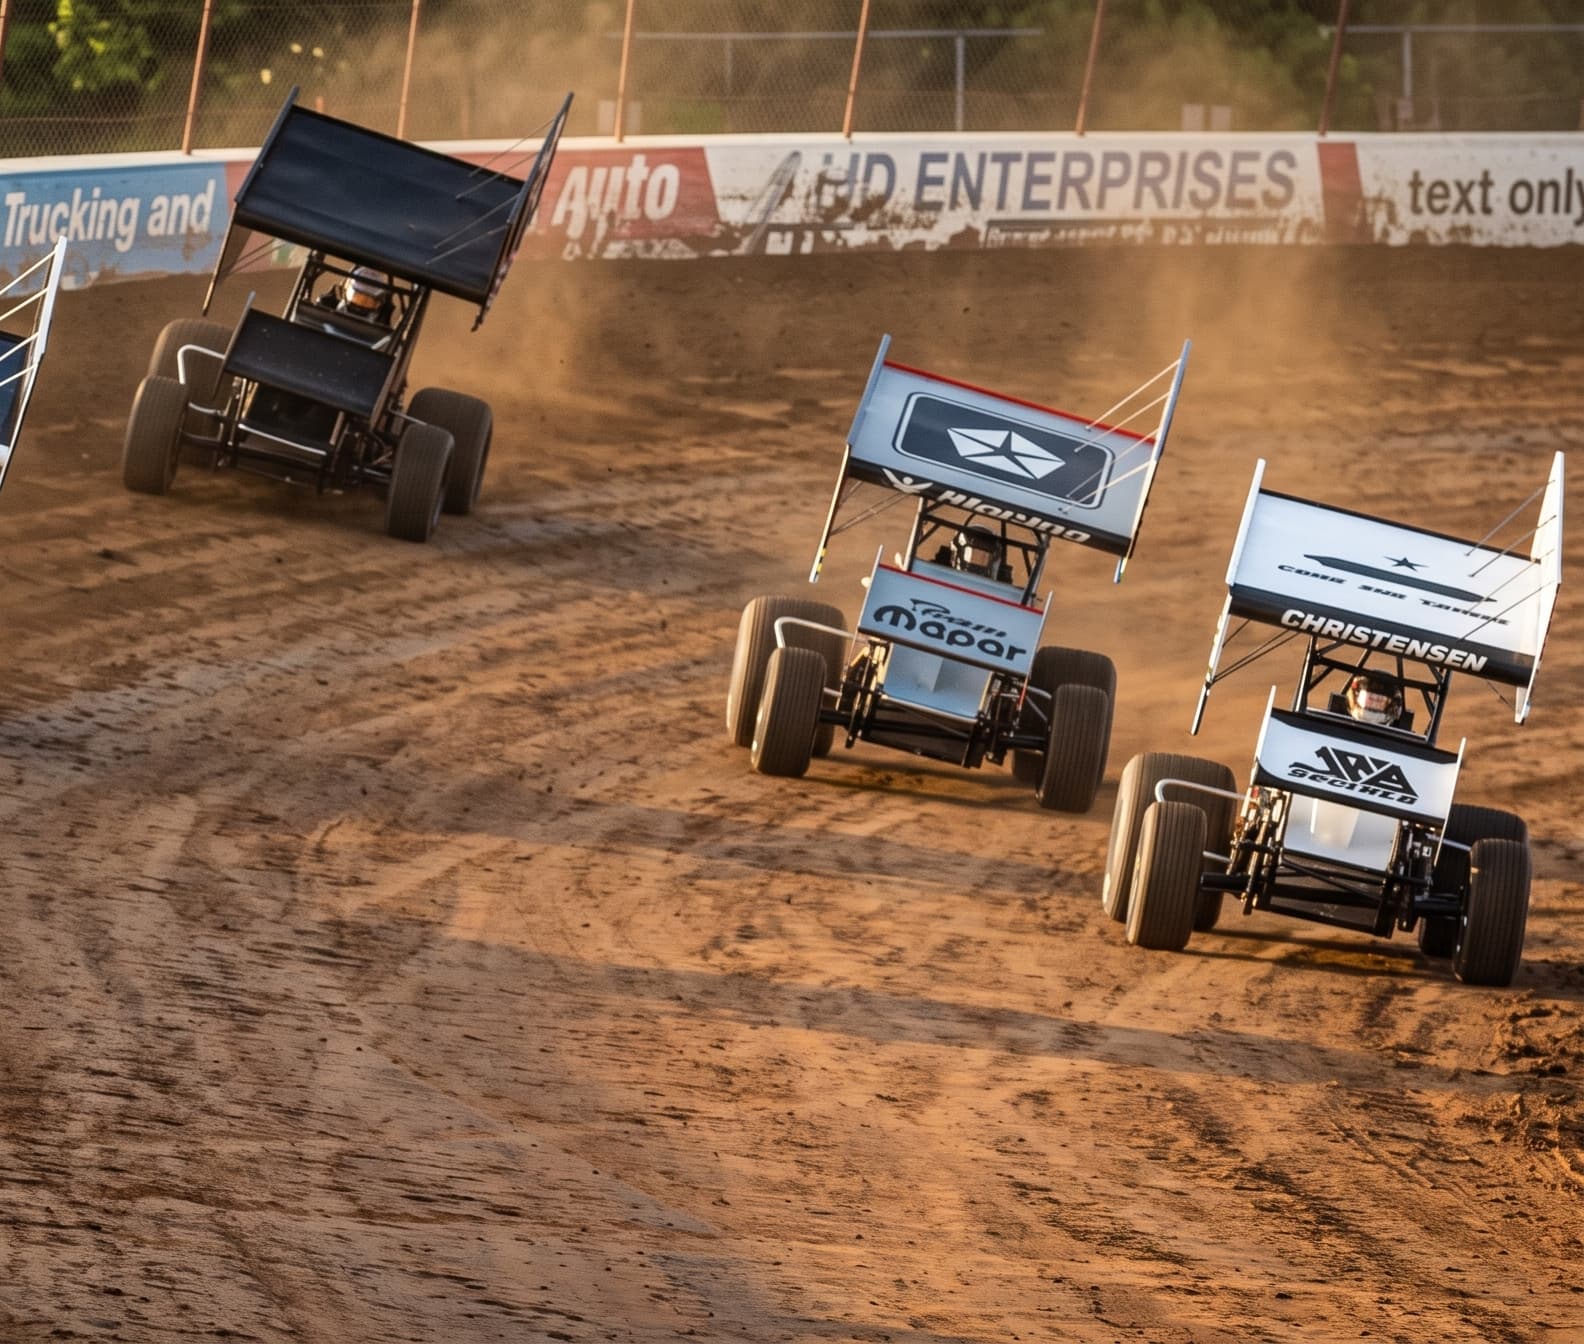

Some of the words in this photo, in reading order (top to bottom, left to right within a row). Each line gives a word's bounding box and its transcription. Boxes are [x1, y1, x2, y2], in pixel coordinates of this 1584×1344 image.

[551, 154, 681, 234] Auto
[914, 150, 1299, 211] ENTERPRISES
[1408, 169, 1495, 215] text
[4, 187, 140, 252] Trucking
[147, 179, 216, 237] and
[1280, 609, 1489, 673] CHRISTENSEN
